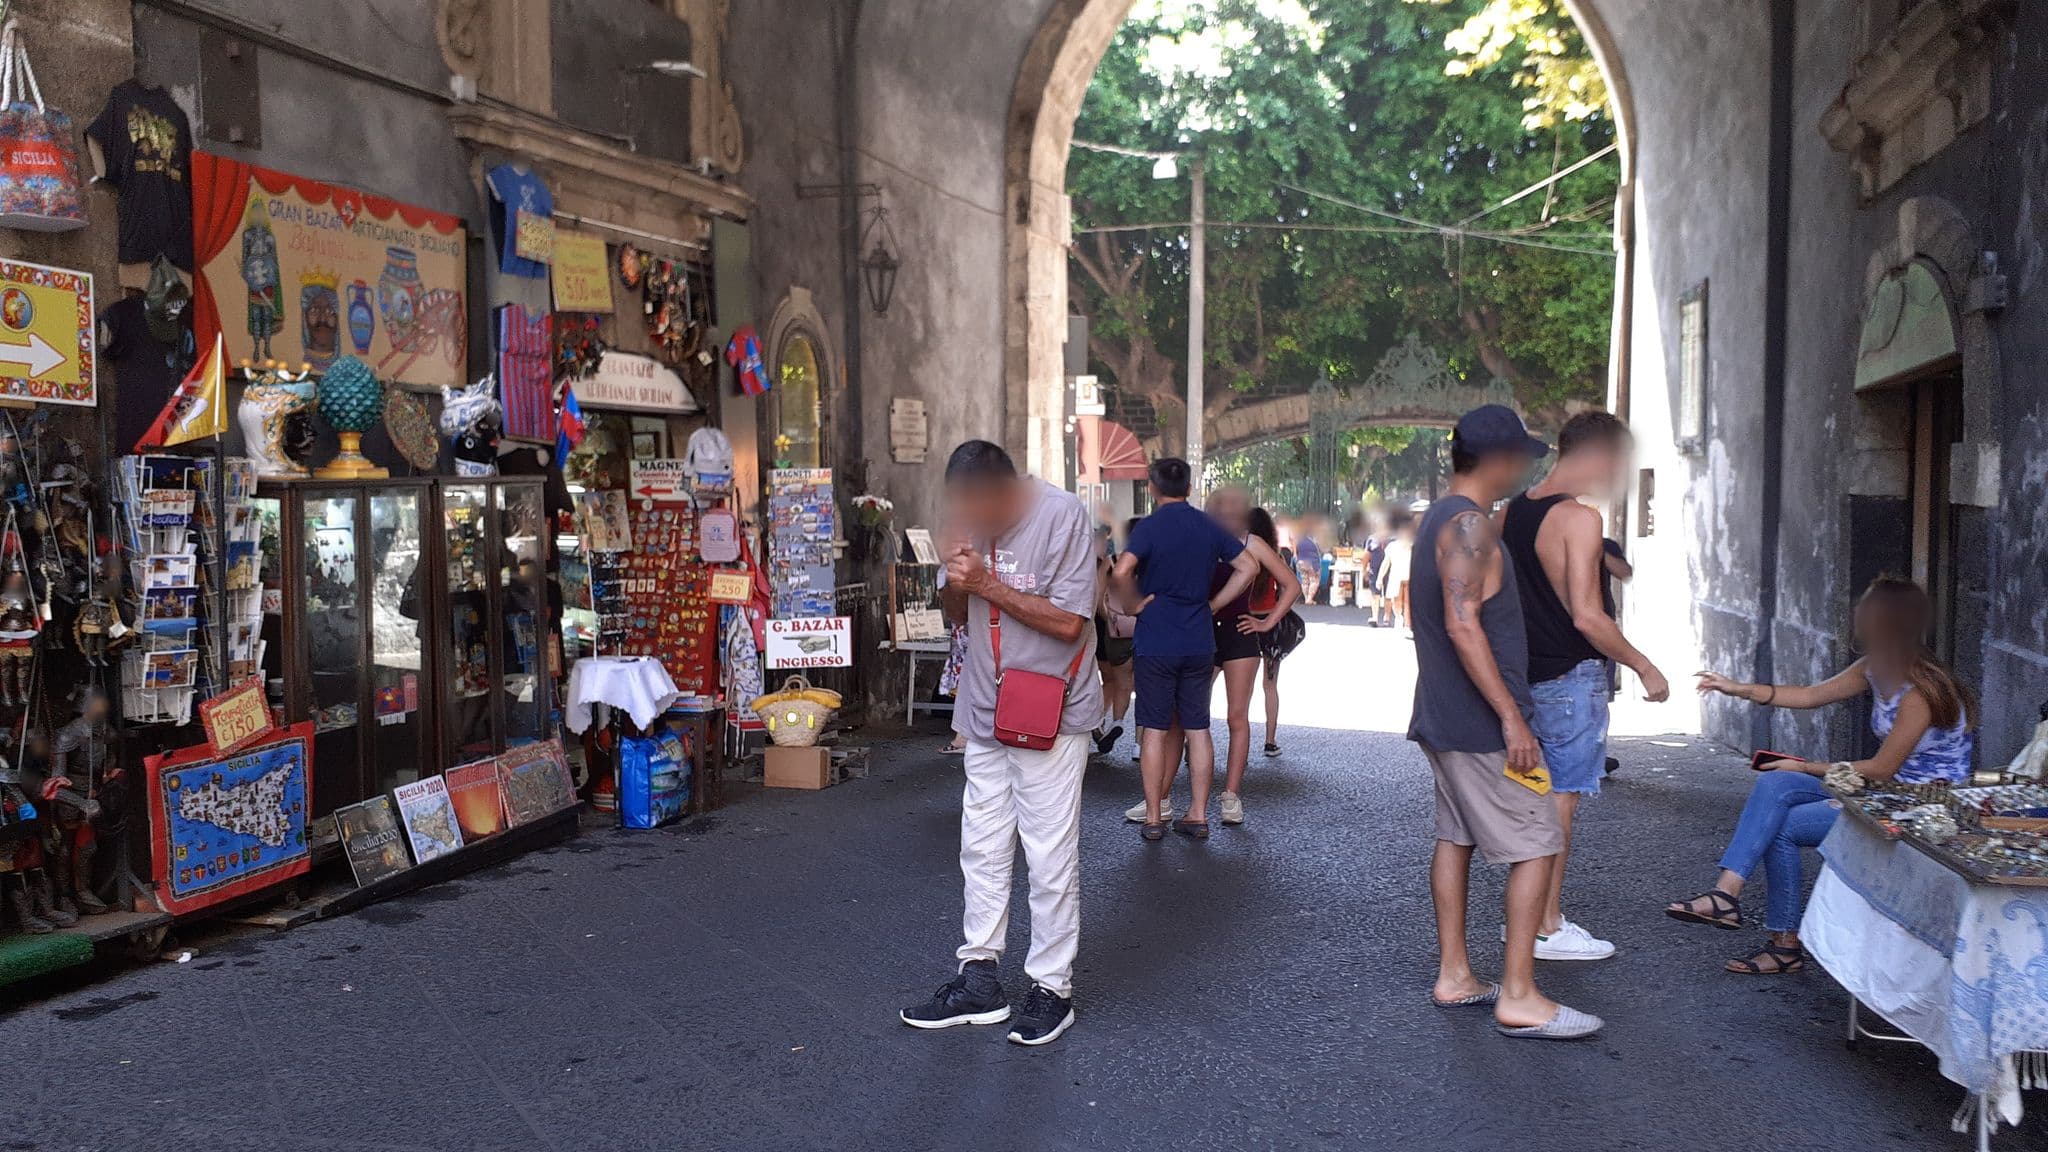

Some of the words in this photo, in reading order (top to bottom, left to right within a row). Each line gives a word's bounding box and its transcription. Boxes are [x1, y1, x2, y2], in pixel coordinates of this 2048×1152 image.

[11, 151, 57, 166] SICILIA
[267, 199, 301, 222] GRAN
[305, 207, 344, 232] BAZAR
[351, 219, 416, 248] ARTIGIANATO
[639, 460, 684, 471] MAGNE
[772, 621, 788, 633] G.
[776, 656, 844, 668] INGRESSO
[227, 755, 262, 772] SICILIA
[398, 785, 426, 801] SICILIA
[426, 779, 444, 796] 2020
